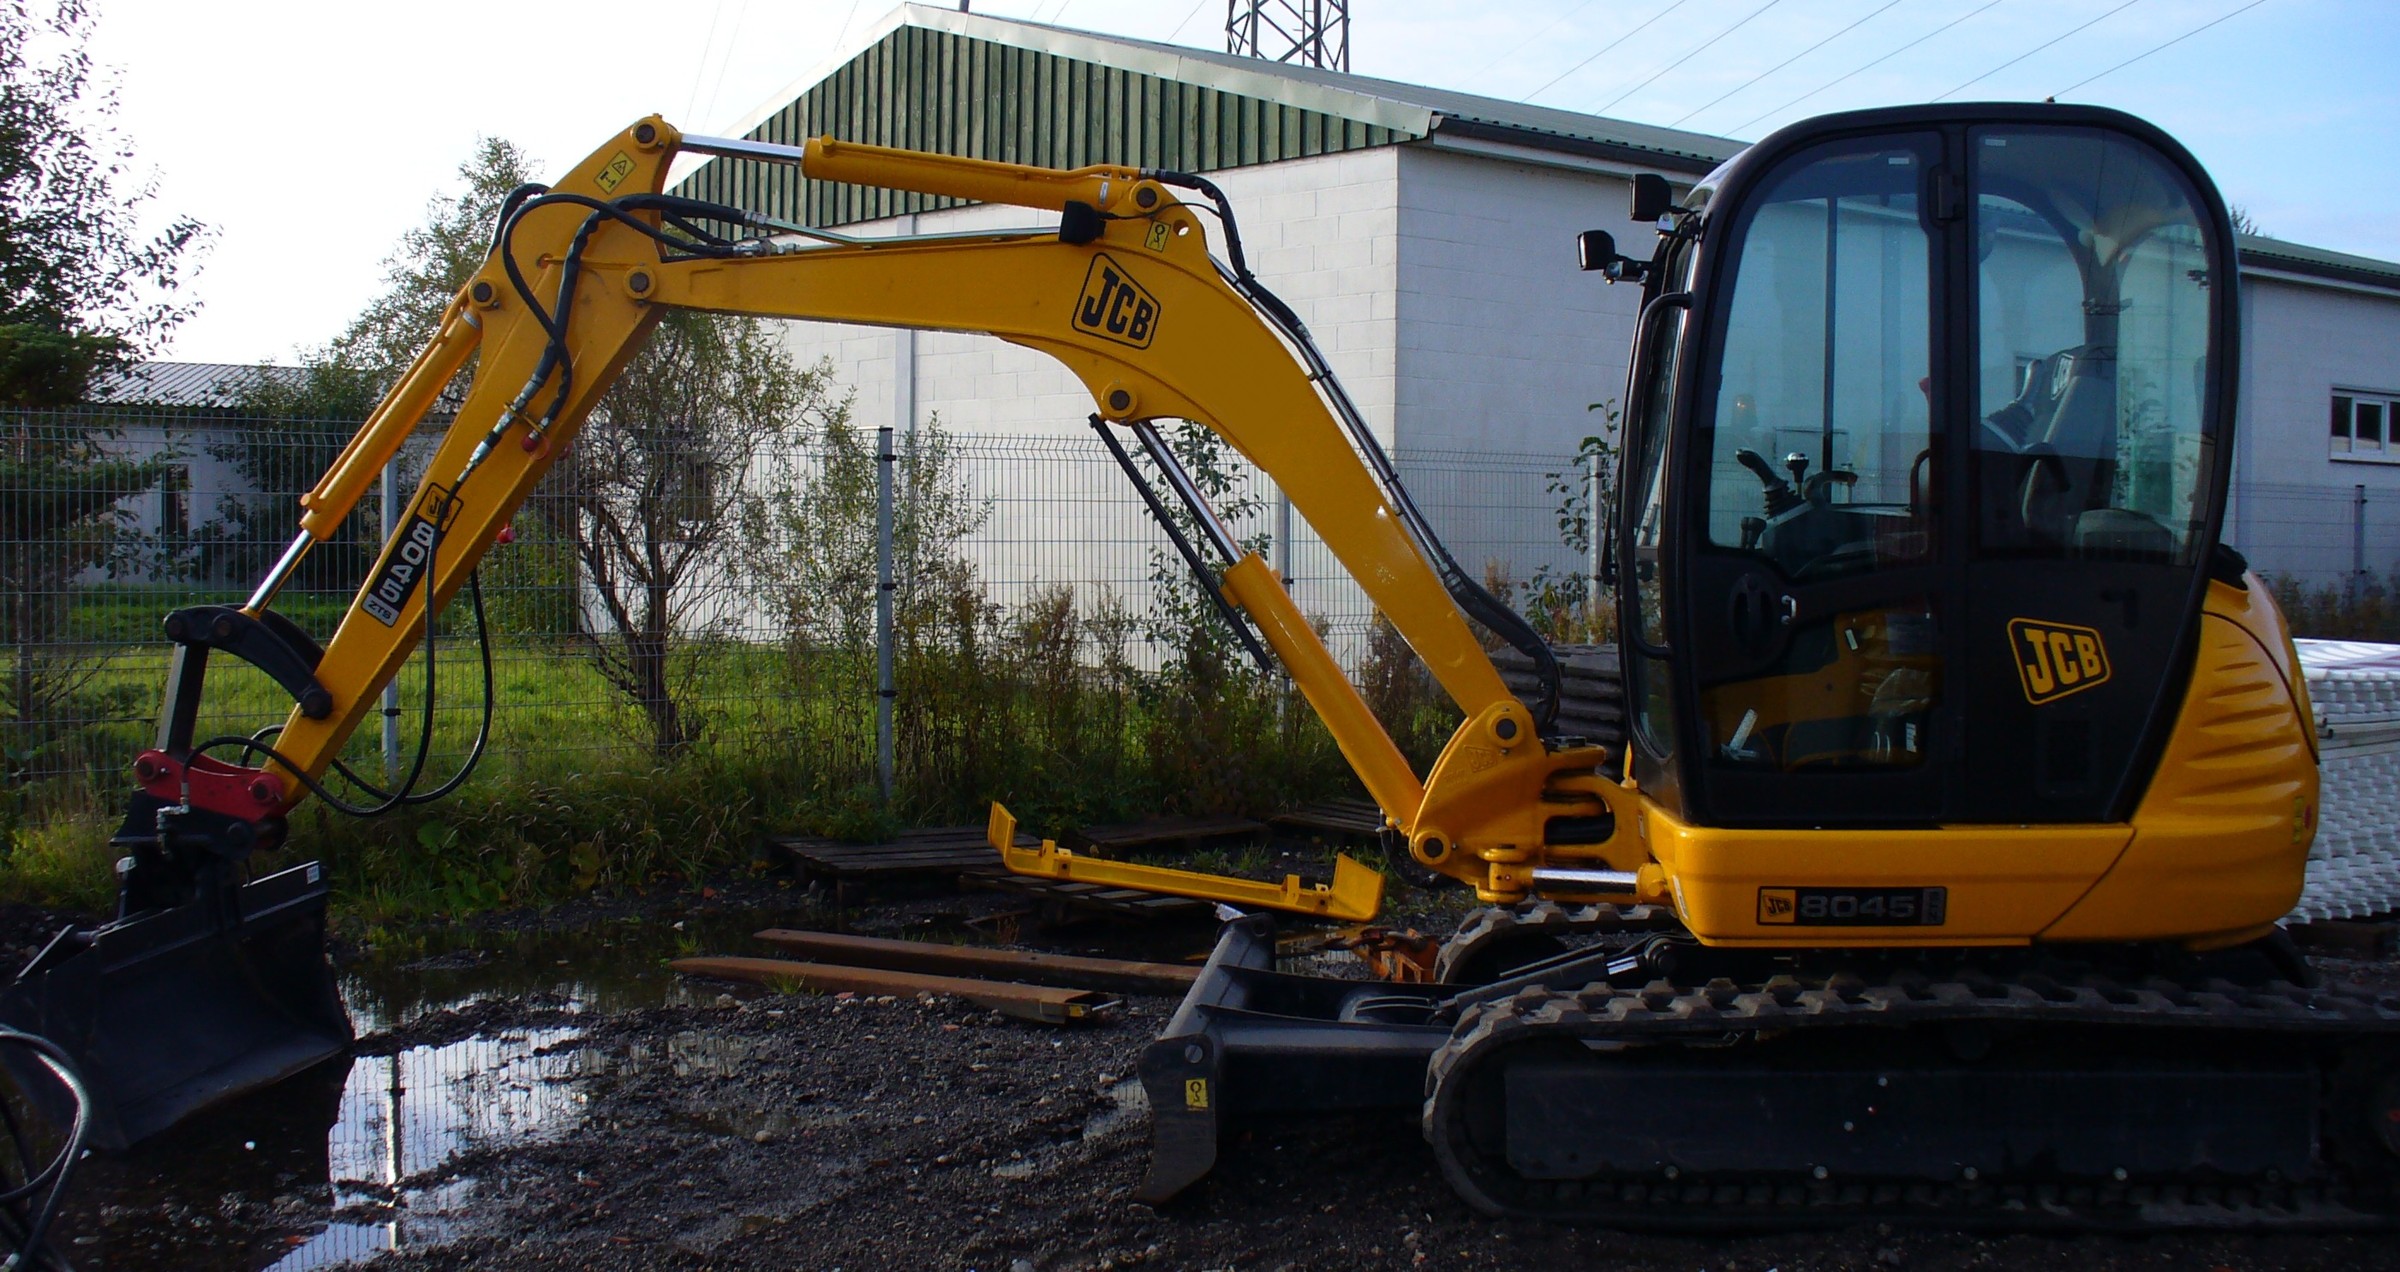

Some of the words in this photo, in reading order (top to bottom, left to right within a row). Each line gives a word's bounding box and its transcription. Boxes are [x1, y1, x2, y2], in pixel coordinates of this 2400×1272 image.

[1081, 266, 1153, 341] JCB
[379, 521, 435, 603] 8045
[368, 599, 392, 620] ZTS
[2024, 628, 2101, 694] JCB
[1767, 897, 1791, 914] JCB
[1800, 895, 1916, 918] 8045
